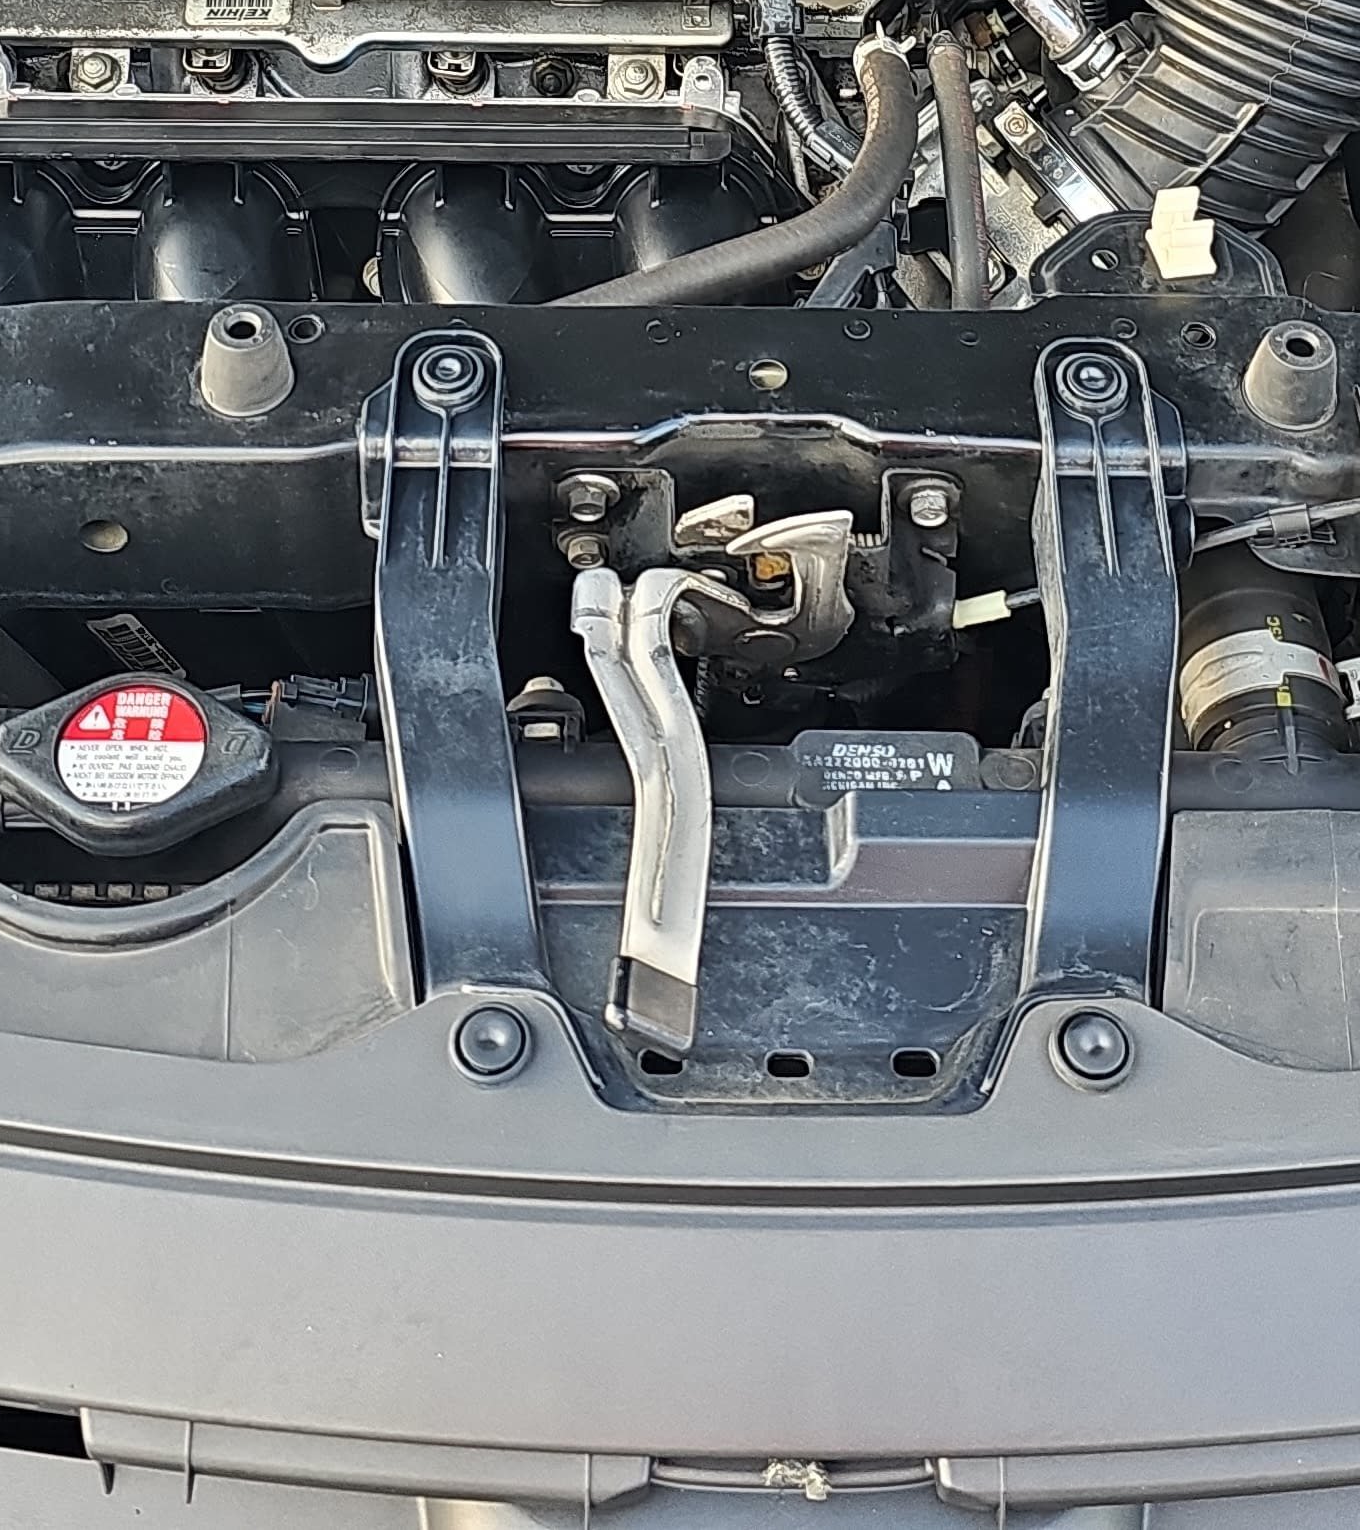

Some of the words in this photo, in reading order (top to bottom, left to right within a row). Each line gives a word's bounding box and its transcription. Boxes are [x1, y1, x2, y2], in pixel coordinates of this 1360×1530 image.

[205, 8, 272, 21] KEIHIN
[116, 692, 171, 705] DANGER
[832, 743, 897, 757] DENSO
